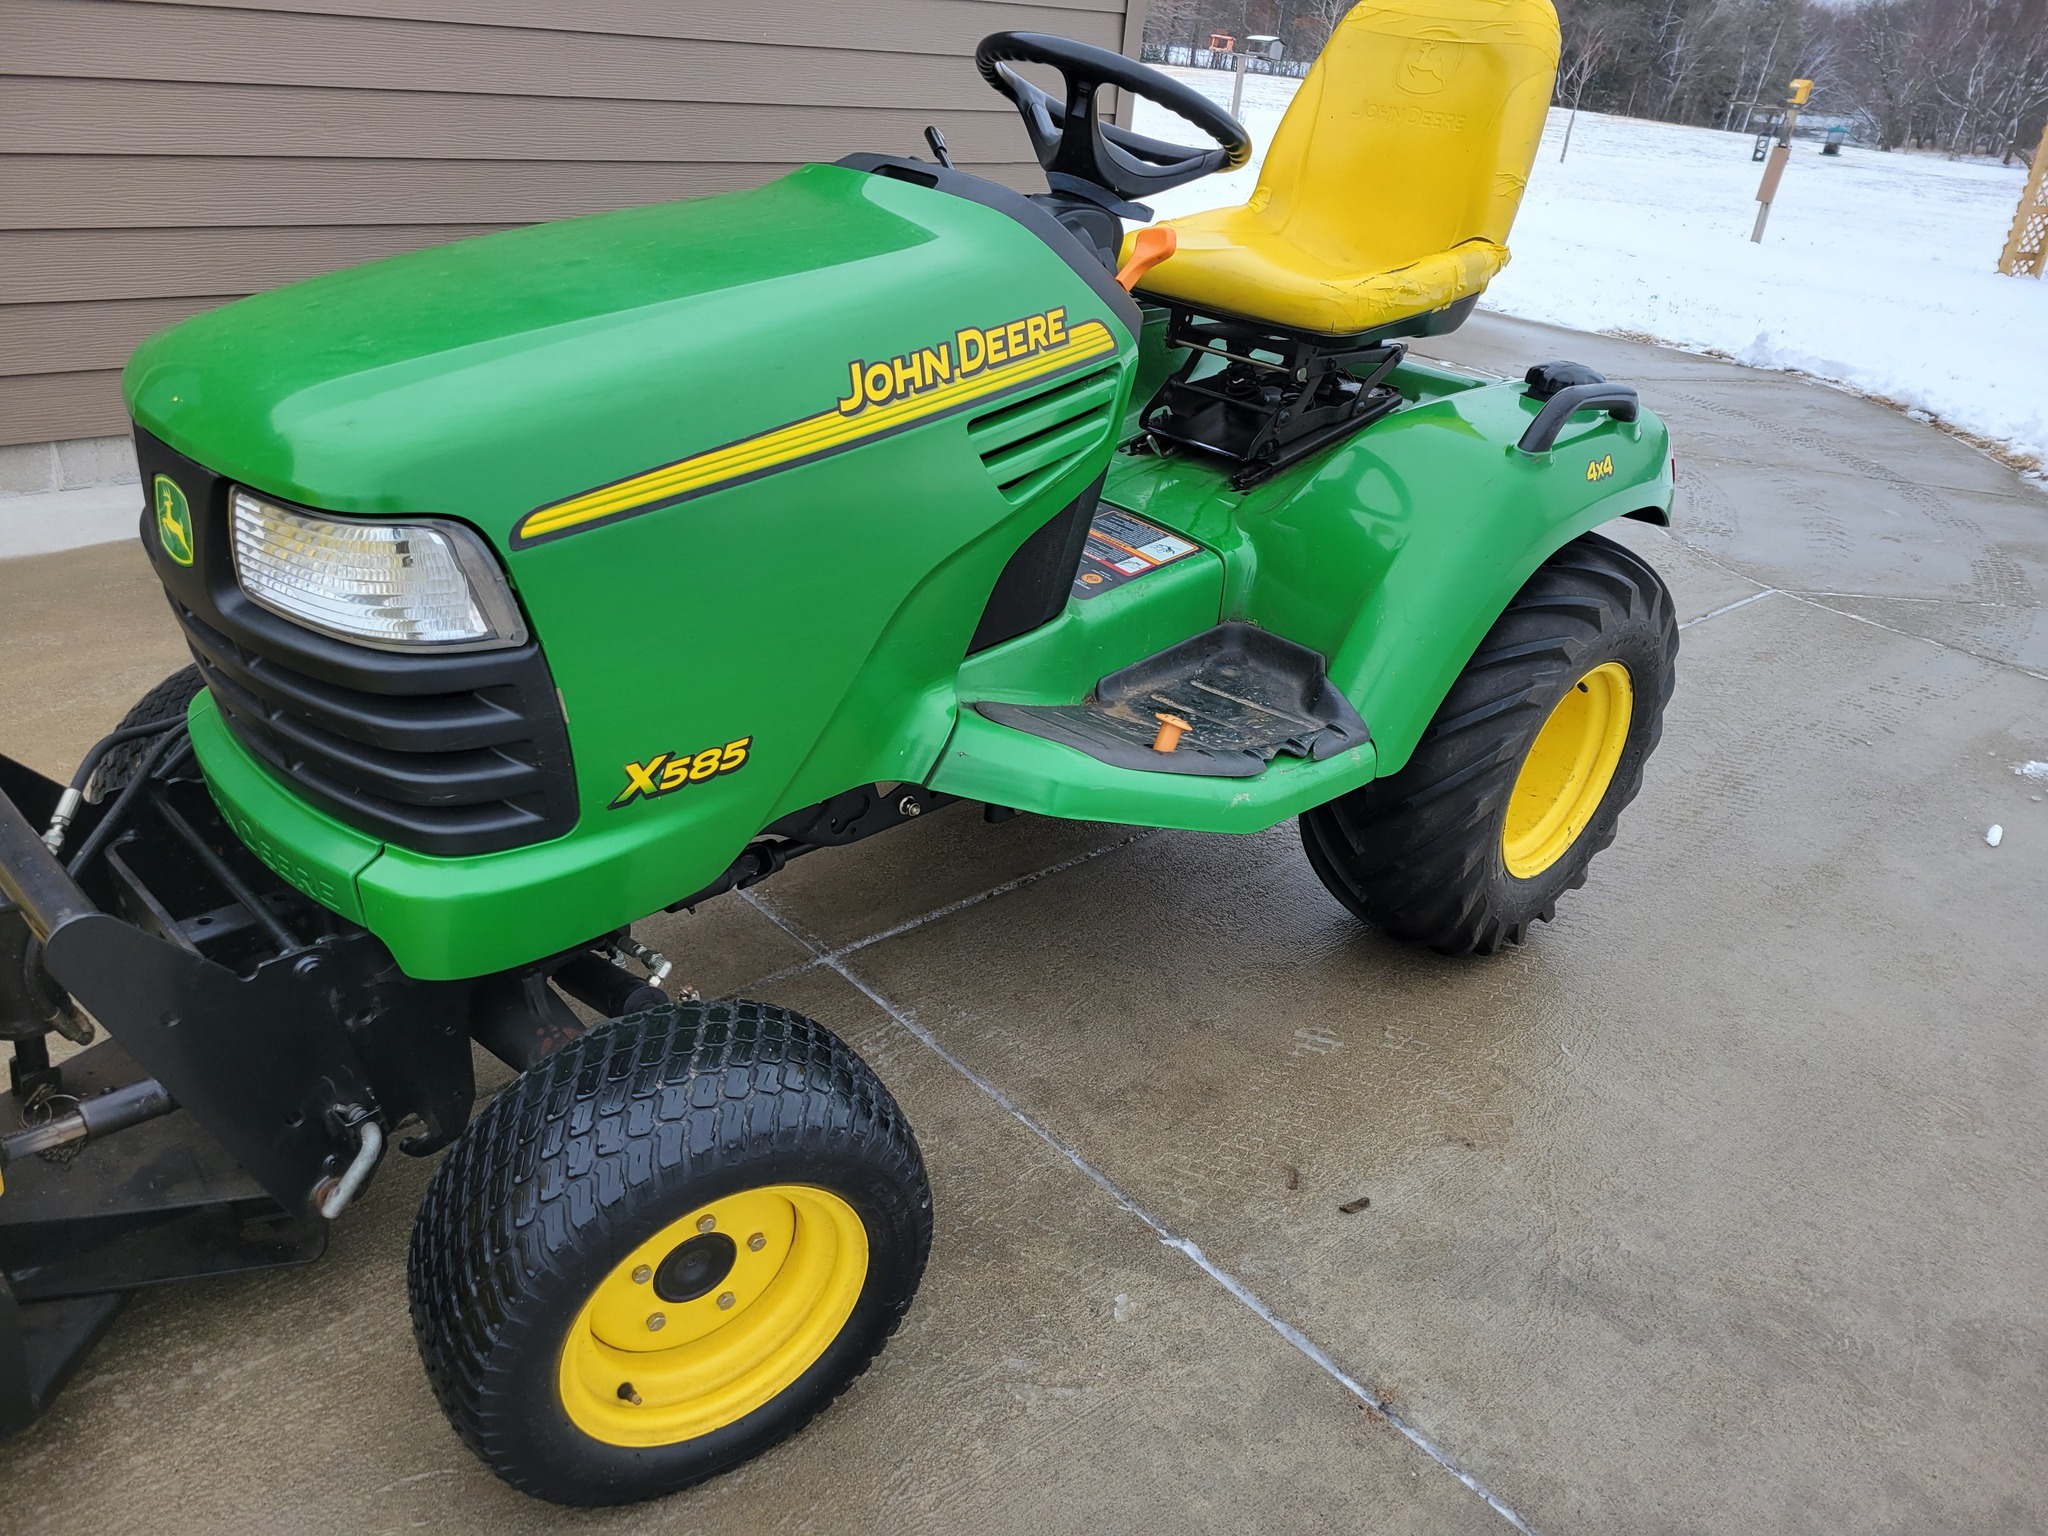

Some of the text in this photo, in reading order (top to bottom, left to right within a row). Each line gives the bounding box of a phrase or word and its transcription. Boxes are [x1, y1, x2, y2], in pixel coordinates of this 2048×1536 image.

[1351, 100, 1467, 132] JOHN DEERE
[838, 305, 1069, 416] JOHN DEERE
[1586, 454, 1614, 482] 4x4
[607, 735, 753, 810] X585
